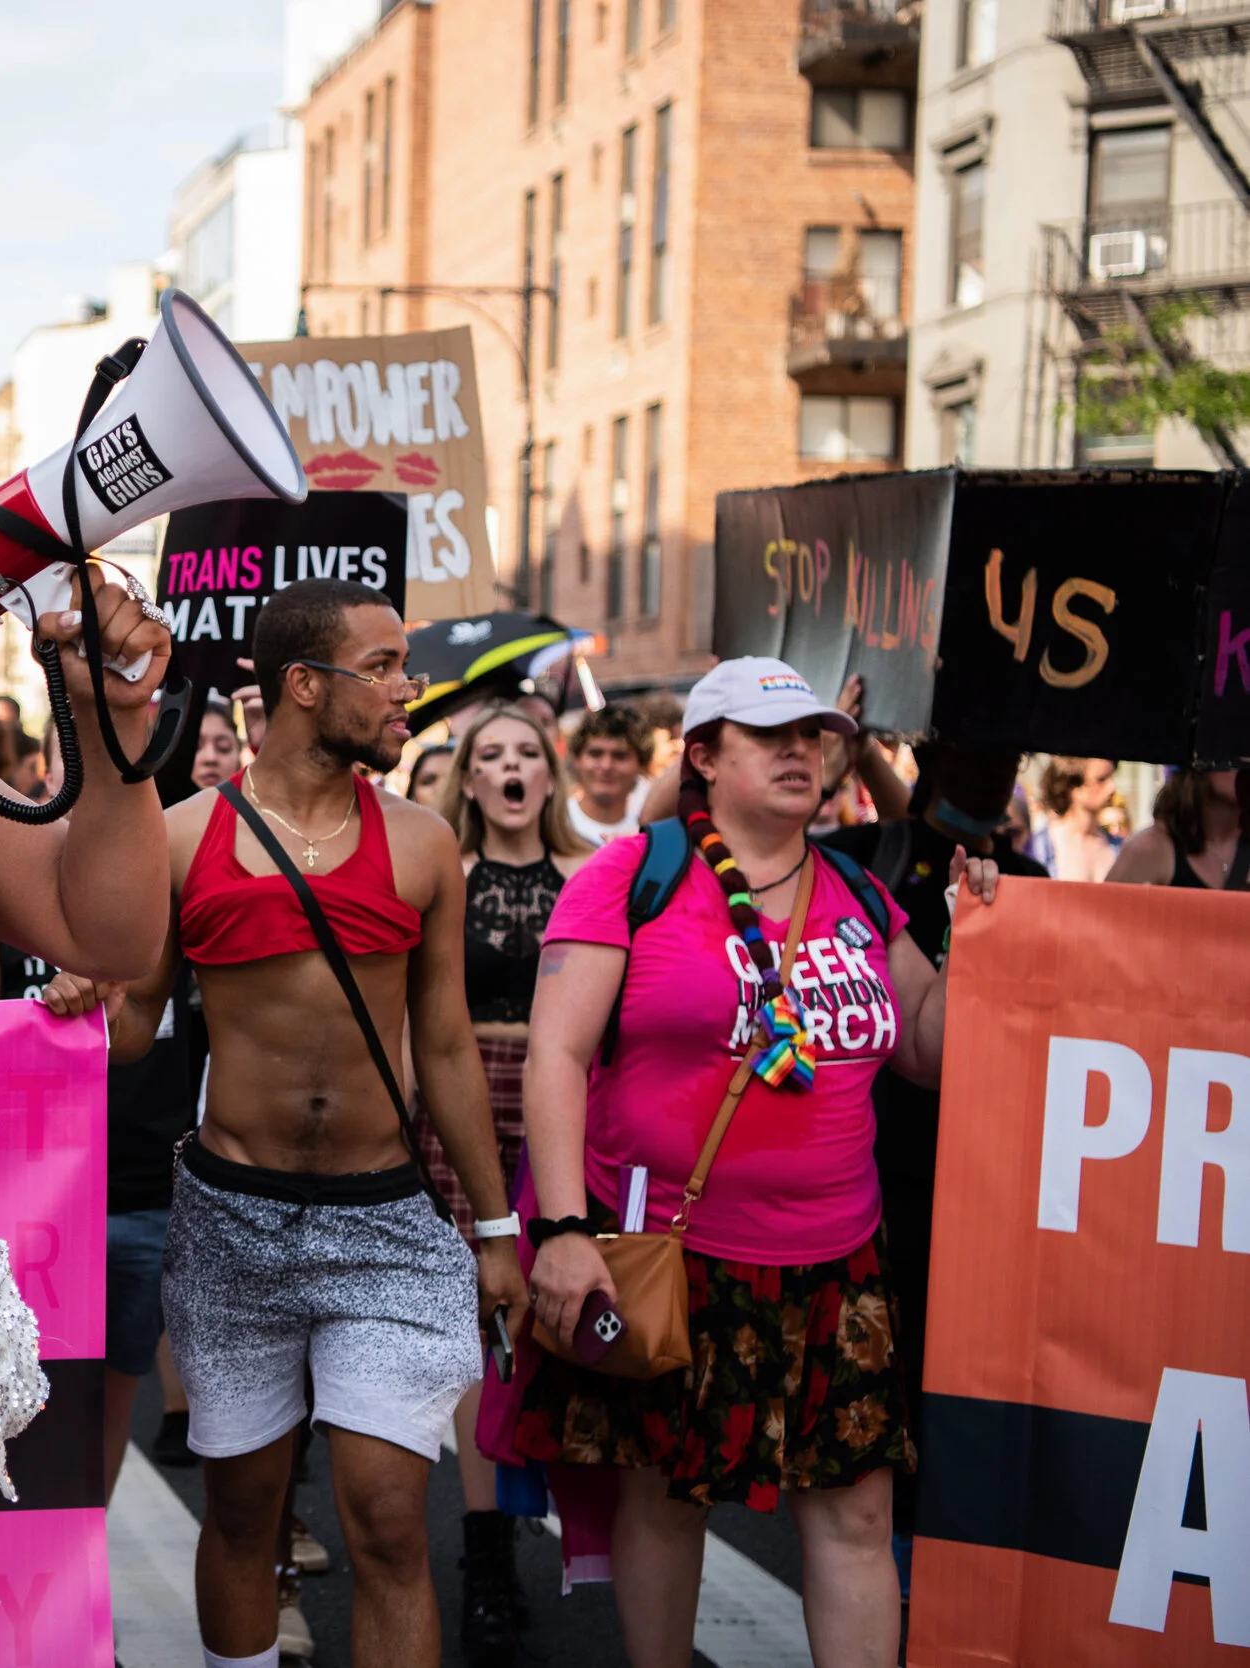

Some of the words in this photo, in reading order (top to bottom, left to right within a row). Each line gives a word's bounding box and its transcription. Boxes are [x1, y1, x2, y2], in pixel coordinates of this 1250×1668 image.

[86, 421, 138, 471] GAYS
[97, 445, 147, 487] AGAINST
[106, 462, 163, 507] GUNS
[168, 546, 263, 595] TRANS
[274, 545, 388, 591] LIVES
[163, 596, 269, 642] MAT
[764, 538, 831, 618] STOP
[843, 540, 936, 677] KILLING
[729, 1001, 897, 1051] MRCH
[1037, 1035, 1250, 1254] PR
